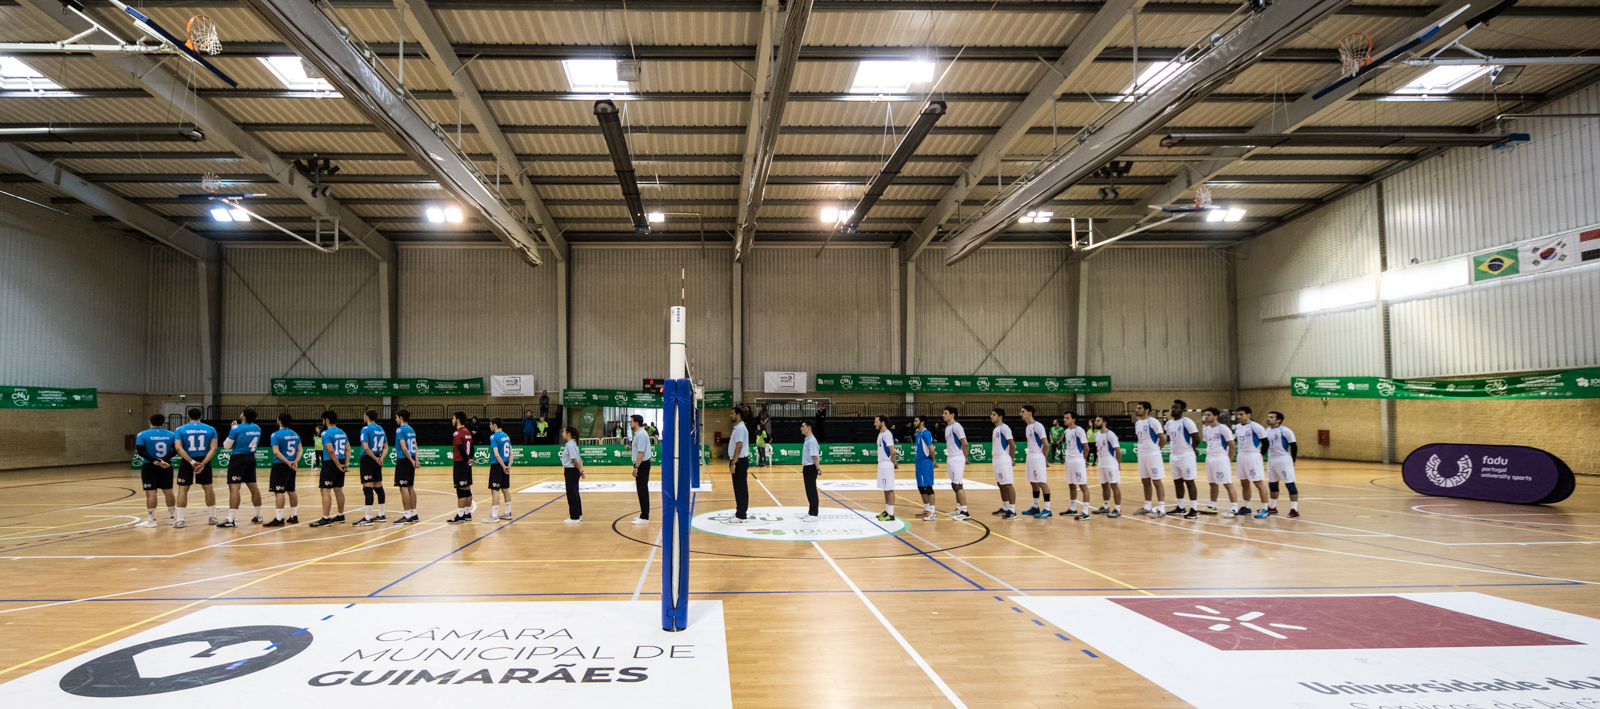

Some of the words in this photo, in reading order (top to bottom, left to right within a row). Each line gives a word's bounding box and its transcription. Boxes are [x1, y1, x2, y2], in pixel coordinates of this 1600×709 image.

[909, 379, 922, 387] CNU
[977, 379, 990, 387] CNU
[12, 392, 29, 401] CNU
[615, 394, 628, 402] CNU
[155, 441, 167, 457] 9
[188, 435, 206, 451] 11
[249, 436, 258, 452] 4
[287, 440, 296, 456] 5
[335, 439, 346, 455] 15
[372, 436, 385, 452] 14
[504, 442, 510, 457] 6
[475, 451, 490, 459] CNU
[1482, 455, 1508, 466] fadu
[1481, 473, 1510, 481] university
[376, 626, 573, 642] CÂMARA
[341, 645, 615, 662] MUNICIPAL
[633, 645, 695, 659] DE
[308, 663, 649, 687] GUIMARÃES
[1297, 679, 1550, 695] Universidade
